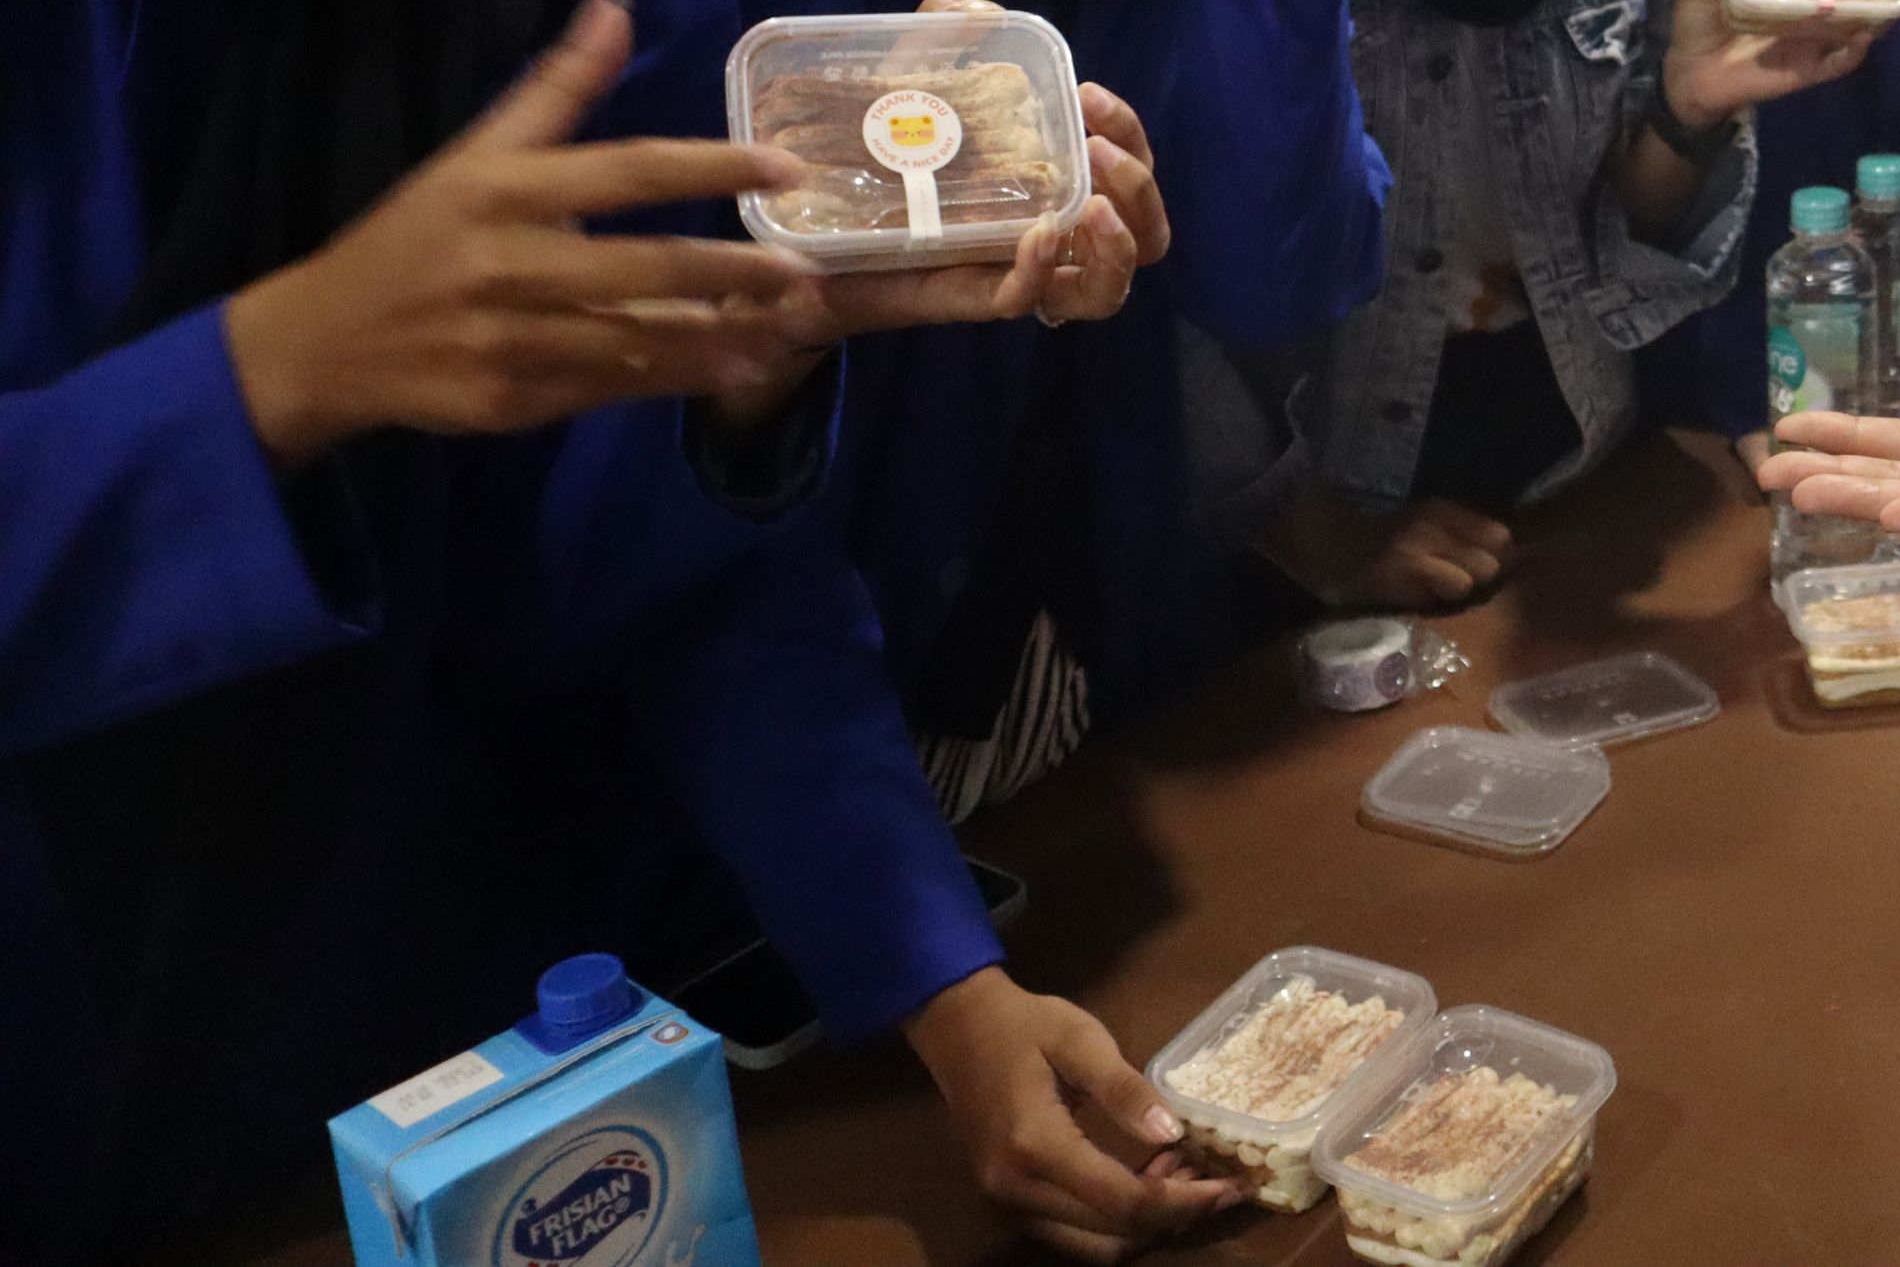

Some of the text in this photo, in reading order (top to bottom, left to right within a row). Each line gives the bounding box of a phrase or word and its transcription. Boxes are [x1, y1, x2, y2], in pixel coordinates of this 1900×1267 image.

[871, 93, 949, 120] THANK YOU
[873, 137, 955, 168] HAVE A NICE DAY
[529, 1173, 631, 1246] FRISIAN
[551, 1209, 616, 1256] FLAG
